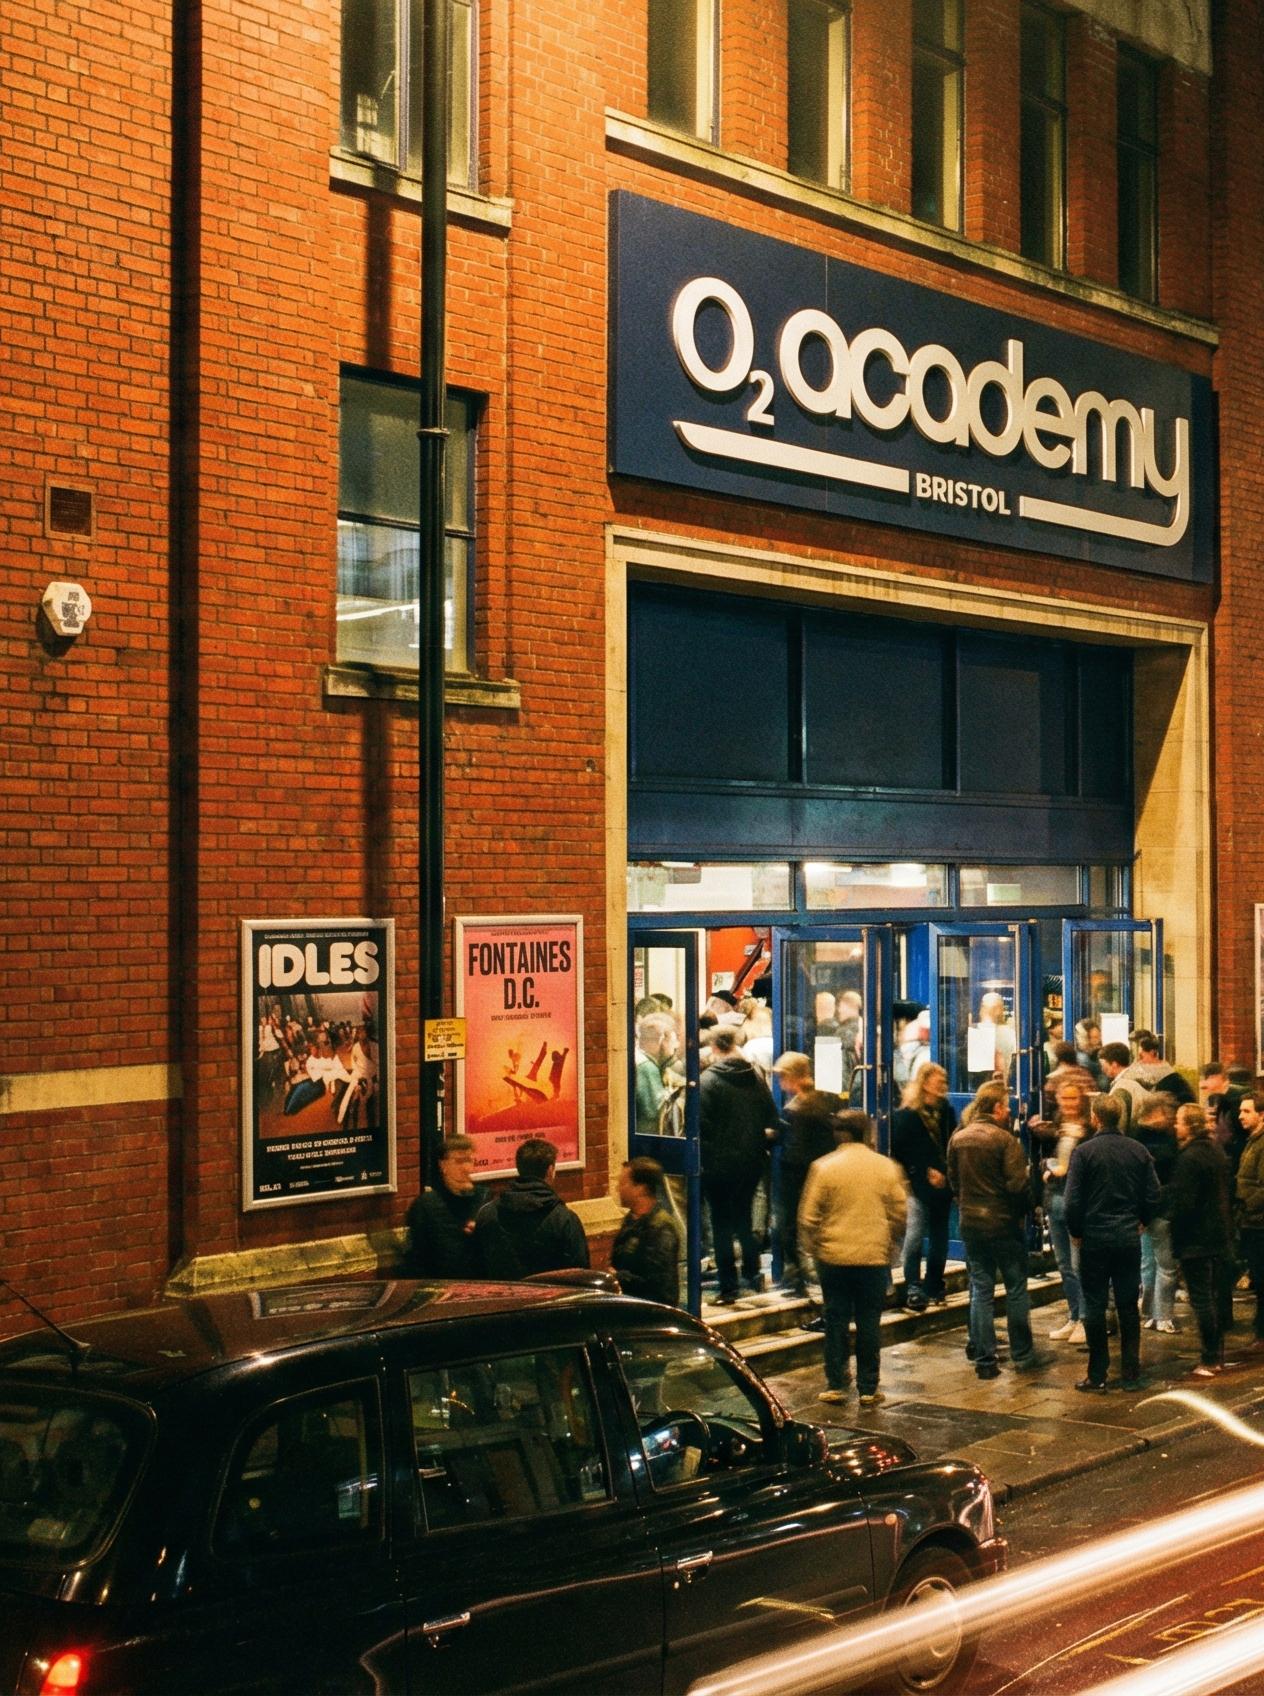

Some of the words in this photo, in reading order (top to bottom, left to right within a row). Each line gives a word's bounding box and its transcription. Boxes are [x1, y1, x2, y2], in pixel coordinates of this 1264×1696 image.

[780, 308, 1189, 546] academy
[916, 472, 1011, 515] BRISTOL
[258, 941, 380, 988] IDLES
[468, 940, 571, 976] FONTAINES
[504, 977, 540, 1009] D.C.
